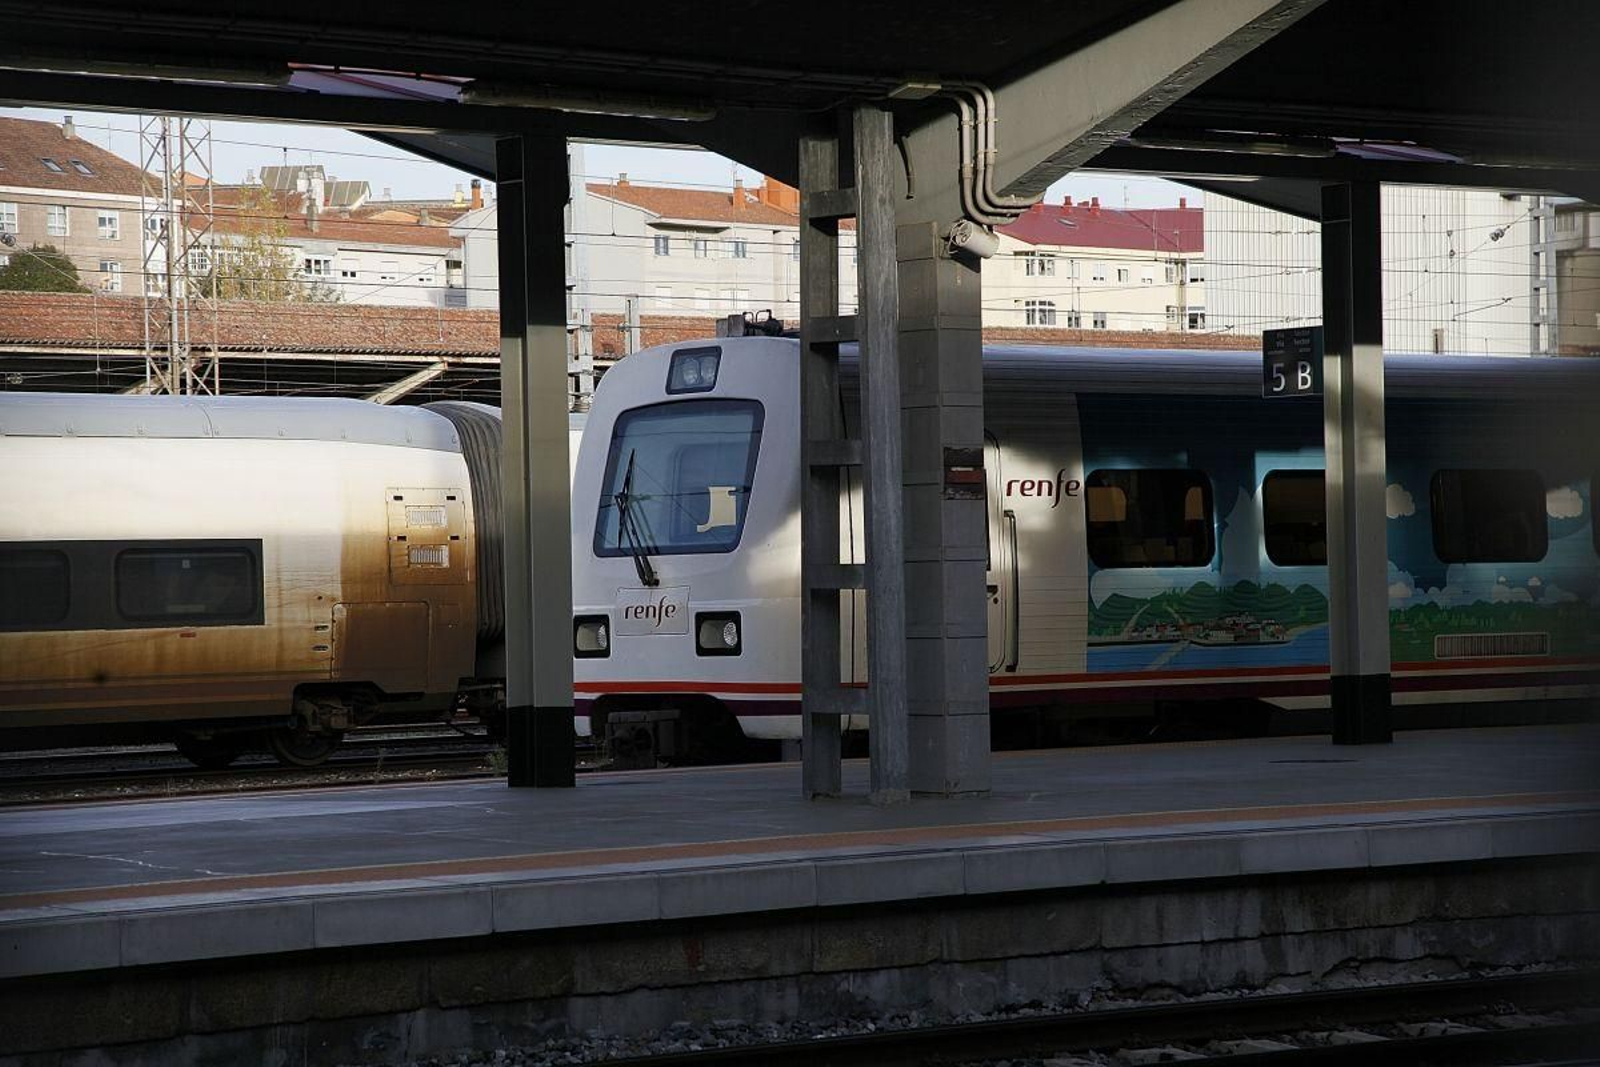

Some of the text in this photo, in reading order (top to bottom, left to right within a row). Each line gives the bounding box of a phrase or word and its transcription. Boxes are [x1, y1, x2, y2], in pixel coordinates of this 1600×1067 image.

[1273, 361, 1312, 392] 5 B
[1006, 468, 1080, 508] renfe
[625, 596, 676, 627] renfe
